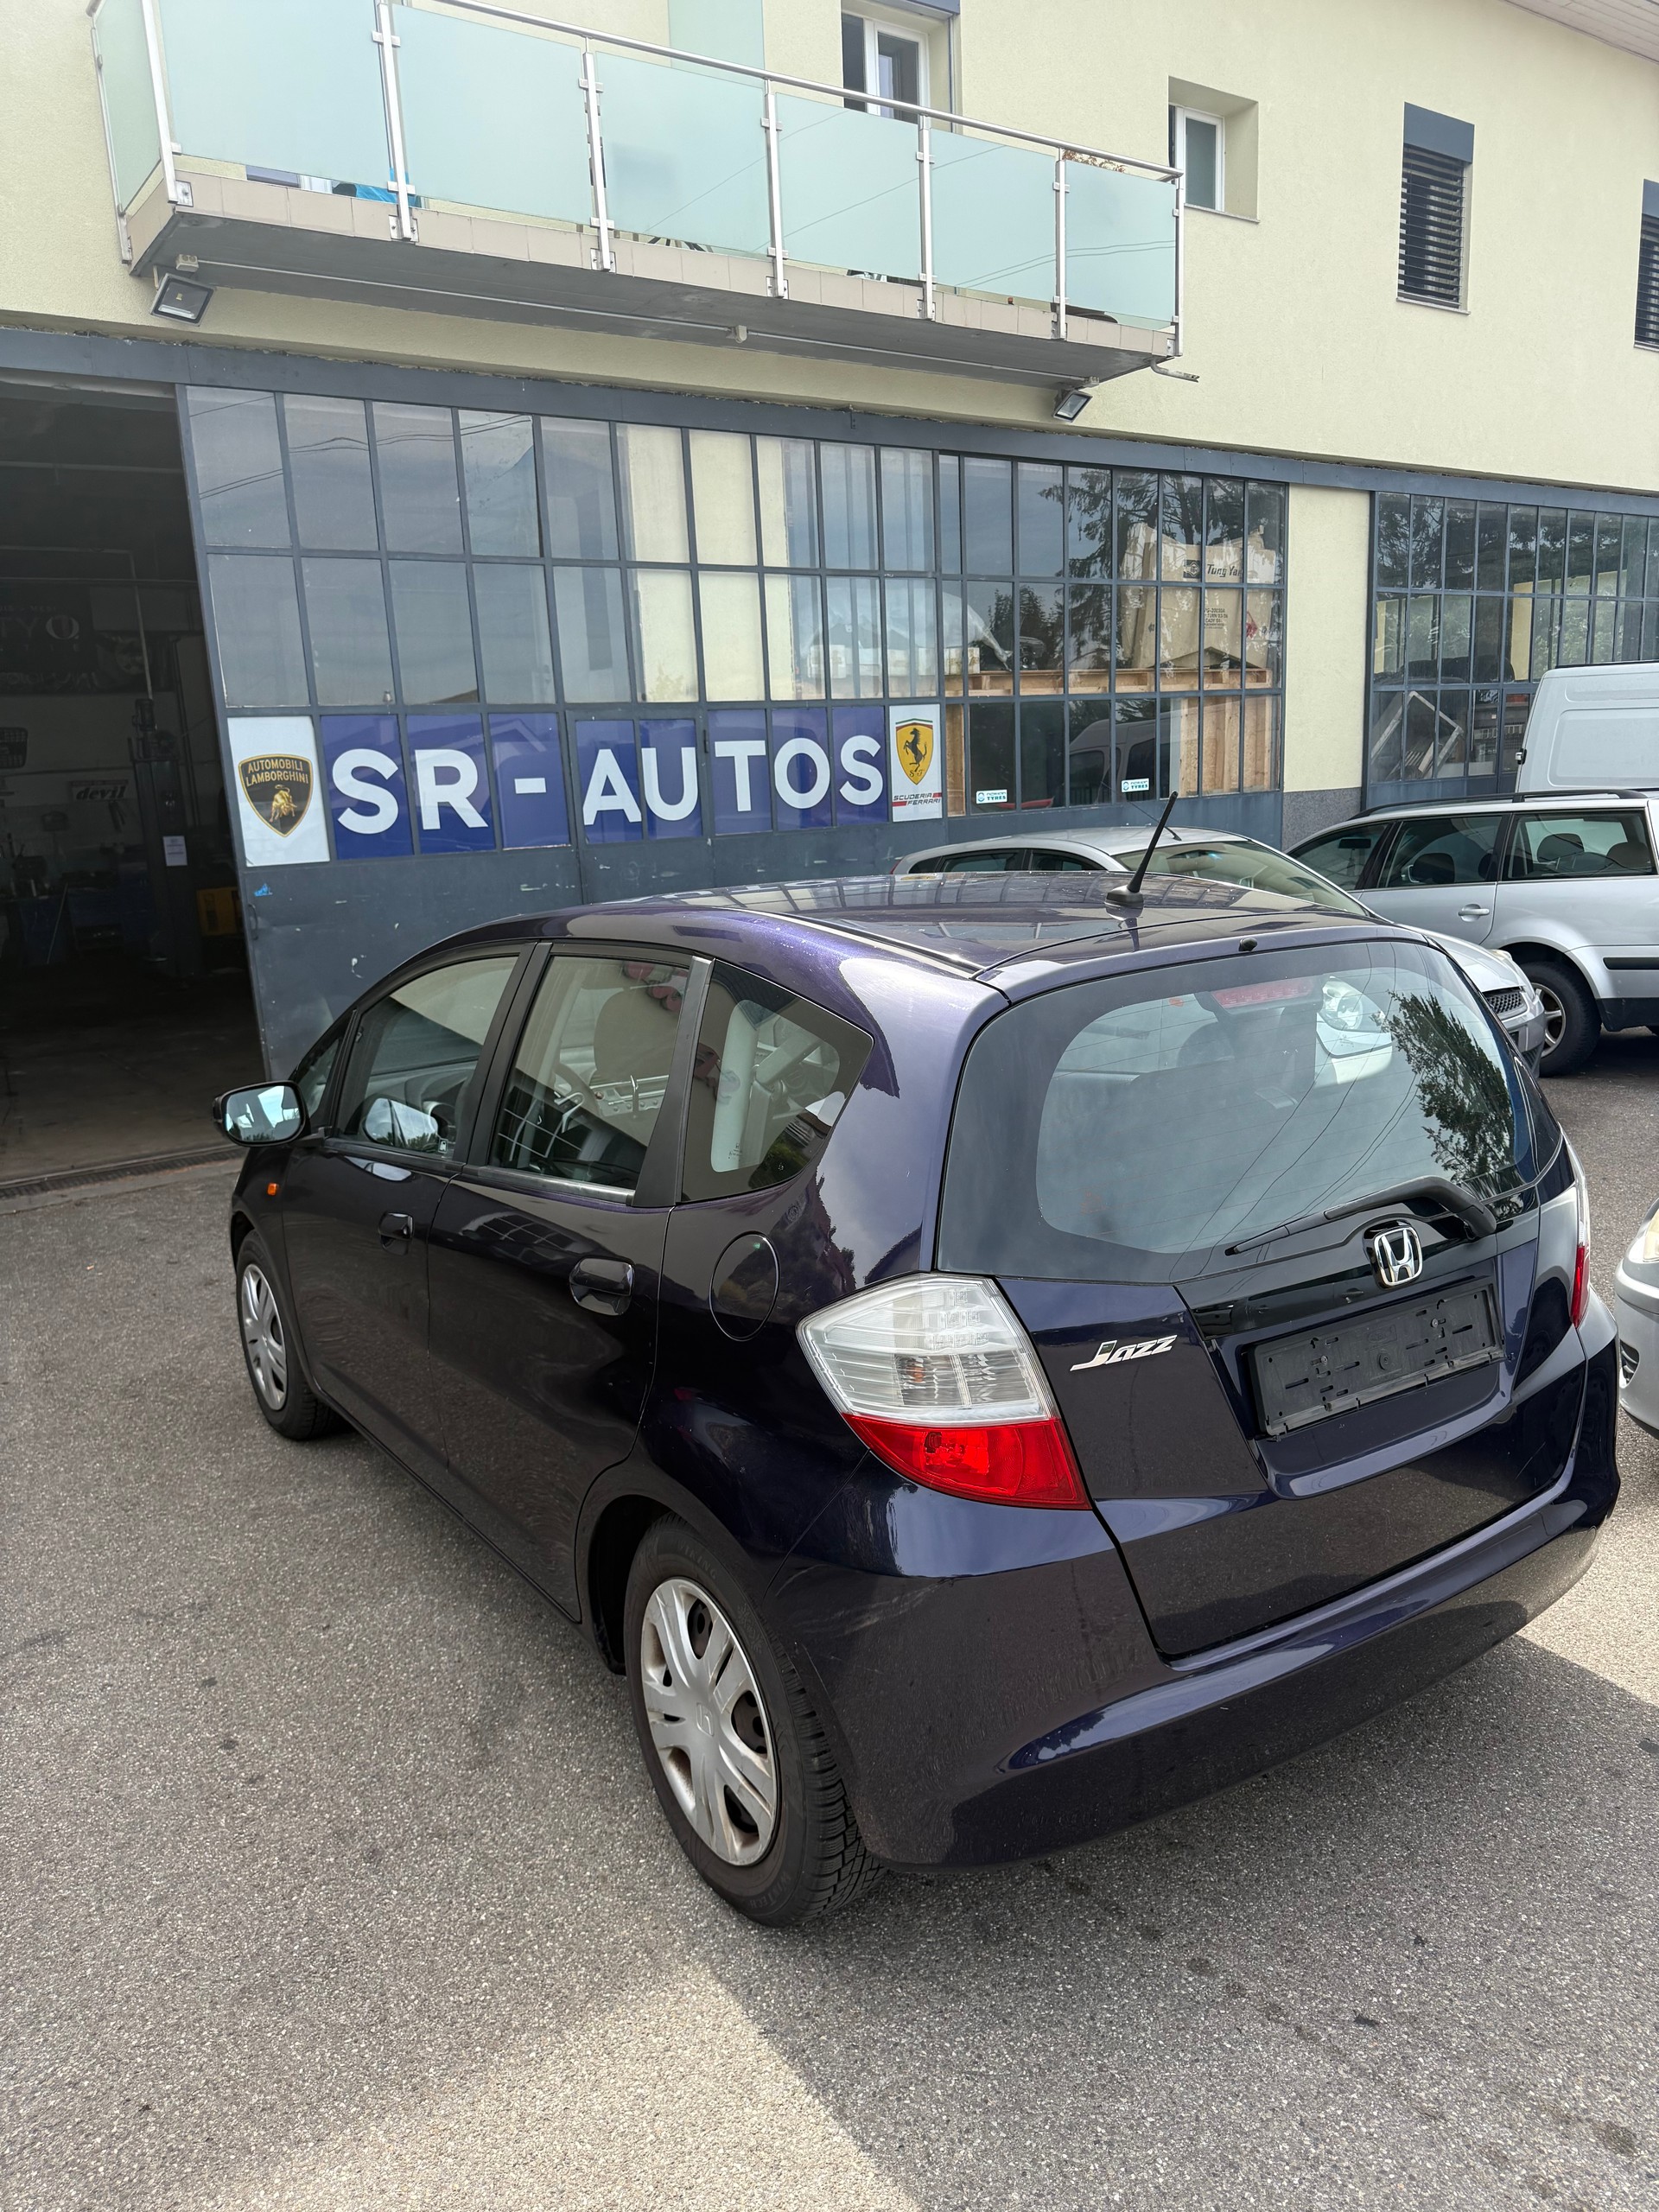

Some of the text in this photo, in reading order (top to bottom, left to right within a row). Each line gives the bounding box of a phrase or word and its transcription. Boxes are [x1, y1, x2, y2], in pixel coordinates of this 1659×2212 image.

[1207, 563, 1227, 578] Tung
[247, 759, 304, 774] AUTOMOBILI
[245, 771, 309, 787] LAMBORGHINI
[76, 785, 126, 801] devil
[893, 792, 932, 801] SCUDERIA
[907, 798, 942, 806] FERRARI
[1070, 1334, 1178, 1372] Jazz
